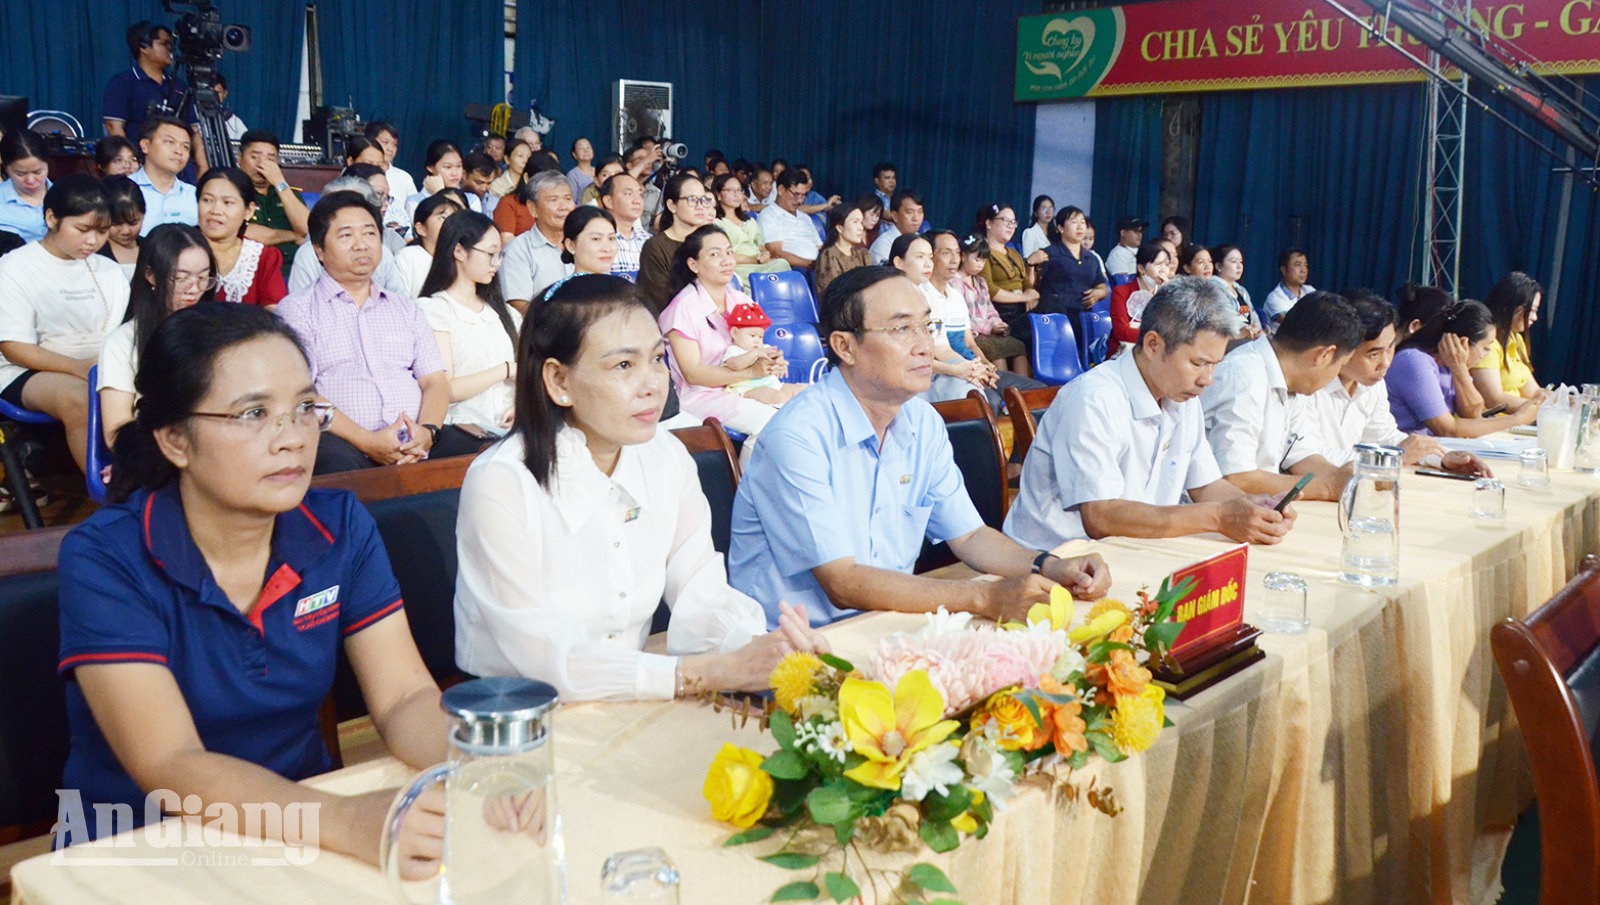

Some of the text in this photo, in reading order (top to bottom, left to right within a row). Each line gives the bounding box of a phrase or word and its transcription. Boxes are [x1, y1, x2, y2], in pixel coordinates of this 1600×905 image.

[1140, 28, 1218, 62] CHIA
[1225, 14, 1264, 57] SẺ
[1273, 9, 1351, 54] YÊU
[296, 586, 339, 616] HTV
[1177, 577, 1238, 622] BAN GIÁM ĐỐC
